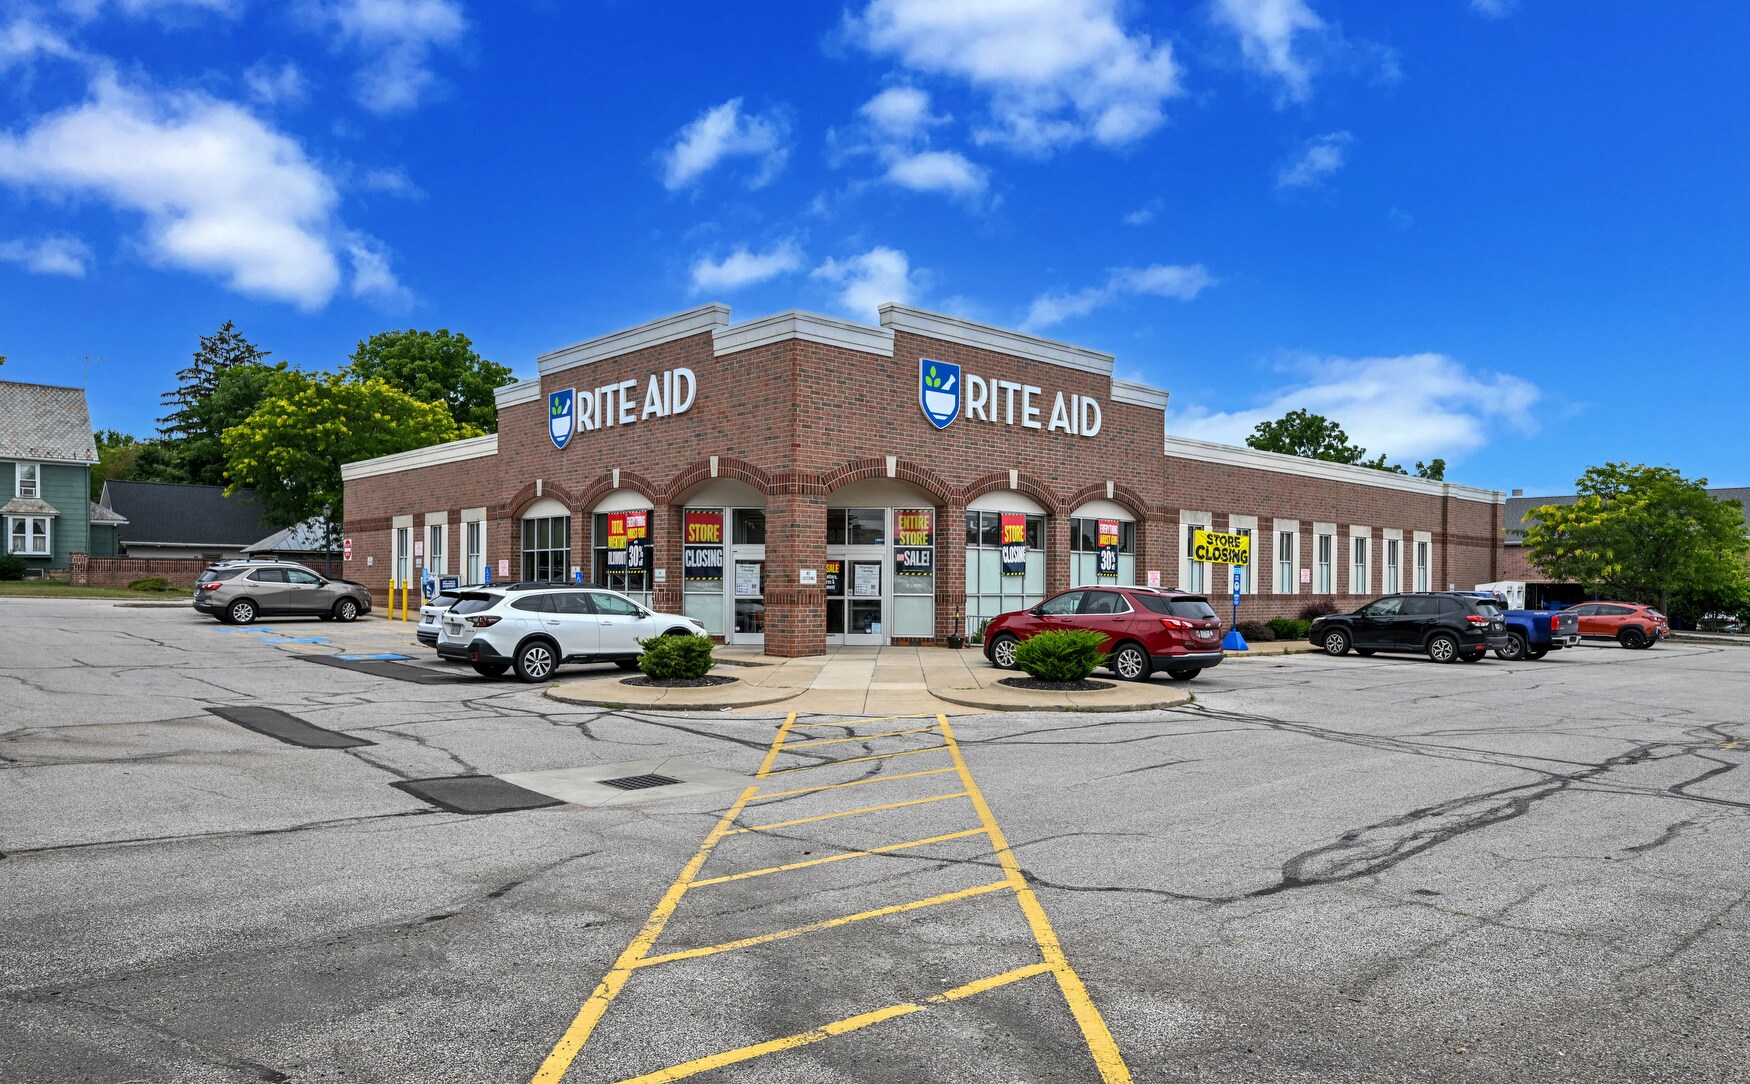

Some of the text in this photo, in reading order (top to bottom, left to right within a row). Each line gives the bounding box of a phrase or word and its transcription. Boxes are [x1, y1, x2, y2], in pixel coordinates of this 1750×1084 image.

[577, 368, 697, 432] RITE AID
[965, 374, 1101, 437] RITE AID
[898, 515, 929, 530] ENTIRE
[688, 523, 720, 542] STORE
[899, 531, 928, 545] STORE
[1004, 525, 1024, 542] STORE
[1207, 534, 1240, 548] STORE
[685, 549, 723, 567] CLOSING
[904, 551, 930, 566] SALE!
[1003, 546, 1025, 563] CLOSING
[1195, 545, 1248, 564] CLOSING
[826, 564, 839, 573] SALE
